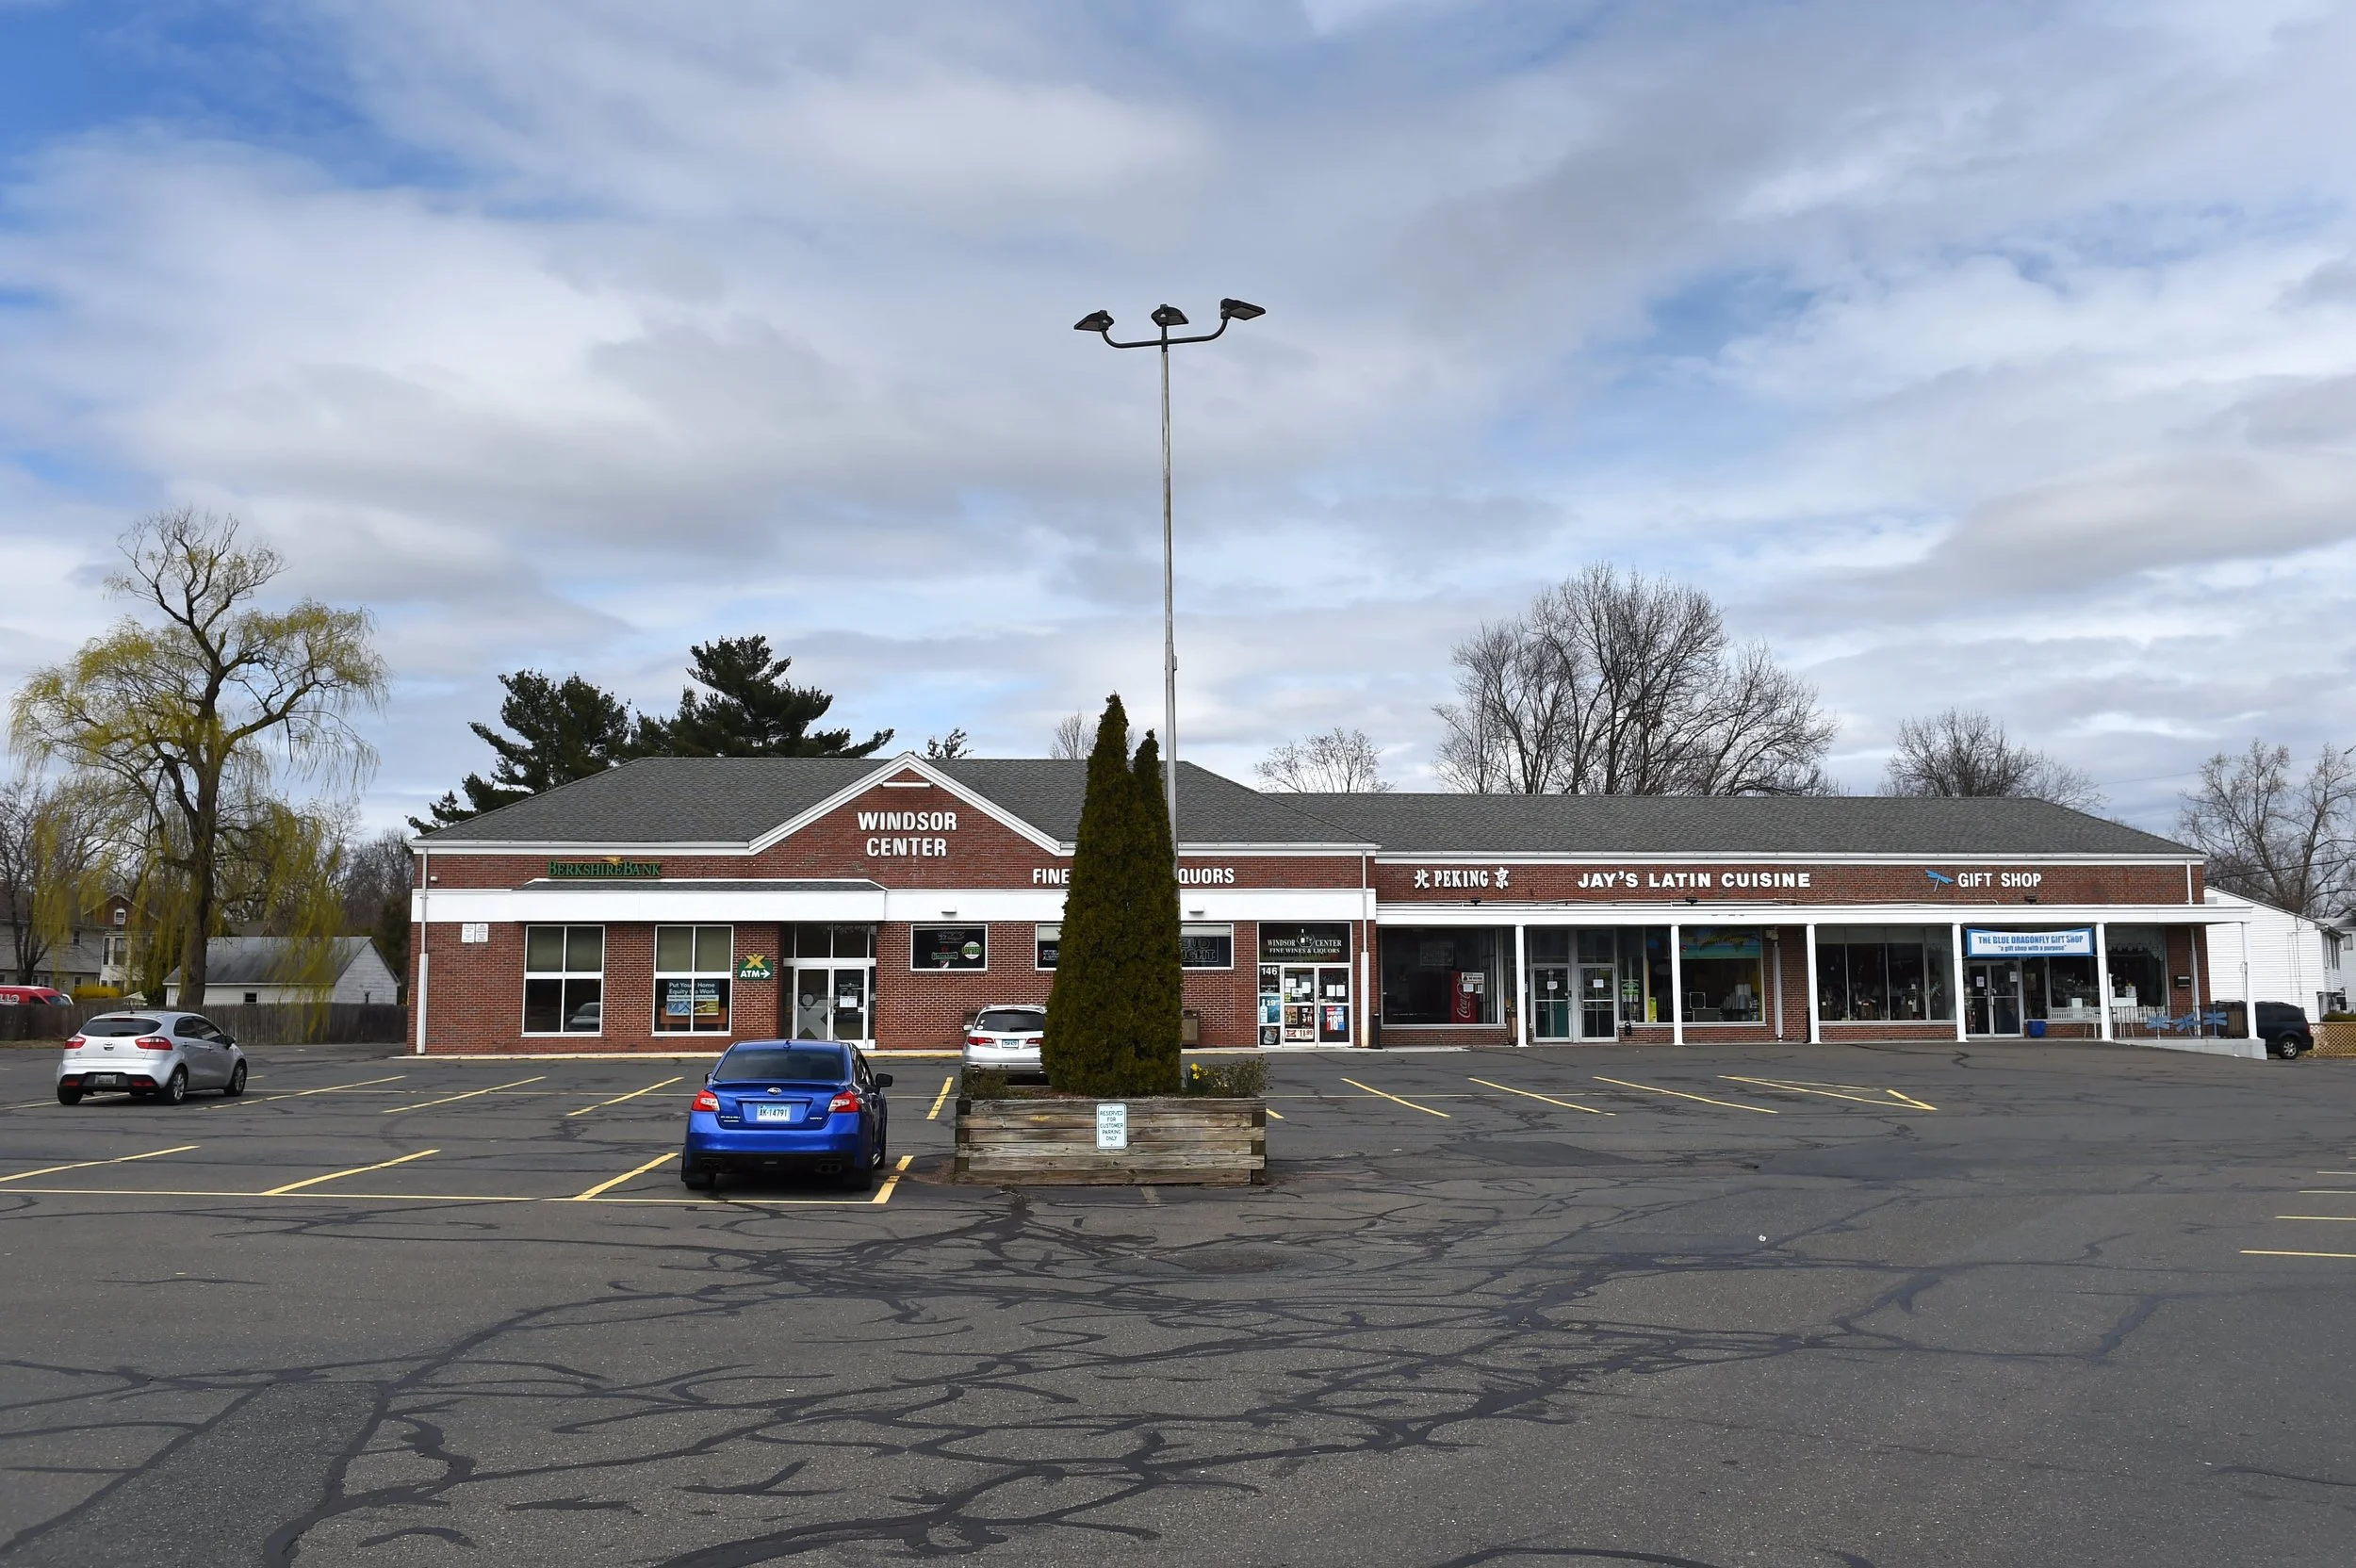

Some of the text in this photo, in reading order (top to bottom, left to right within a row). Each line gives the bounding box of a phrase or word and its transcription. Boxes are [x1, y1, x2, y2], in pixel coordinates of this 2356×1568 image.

[858, 811, 957, 831] WINDSOR
[866, 837, 947, 857] CENTER
[1033, 868, 1235, 884] FINE QUORS
[1414, 869, 1431, 889] 北
[1433, 870, 1489, 888] PEKING
[1494, 867, 1510, 890] 京
[1578, 871, 1811, 888] JAY'S LATIN CUISINE
[1957, 873, 2042, 888] GIFT SHOP
[1978, 935, 2084, 944] THE BLUE DRAGONFLY GIFT SHOP
[1180, 949, 1215, 960] IGHT
[740, 970, 761, 978] ATM
[1261, 967, 1278, 975] 146
